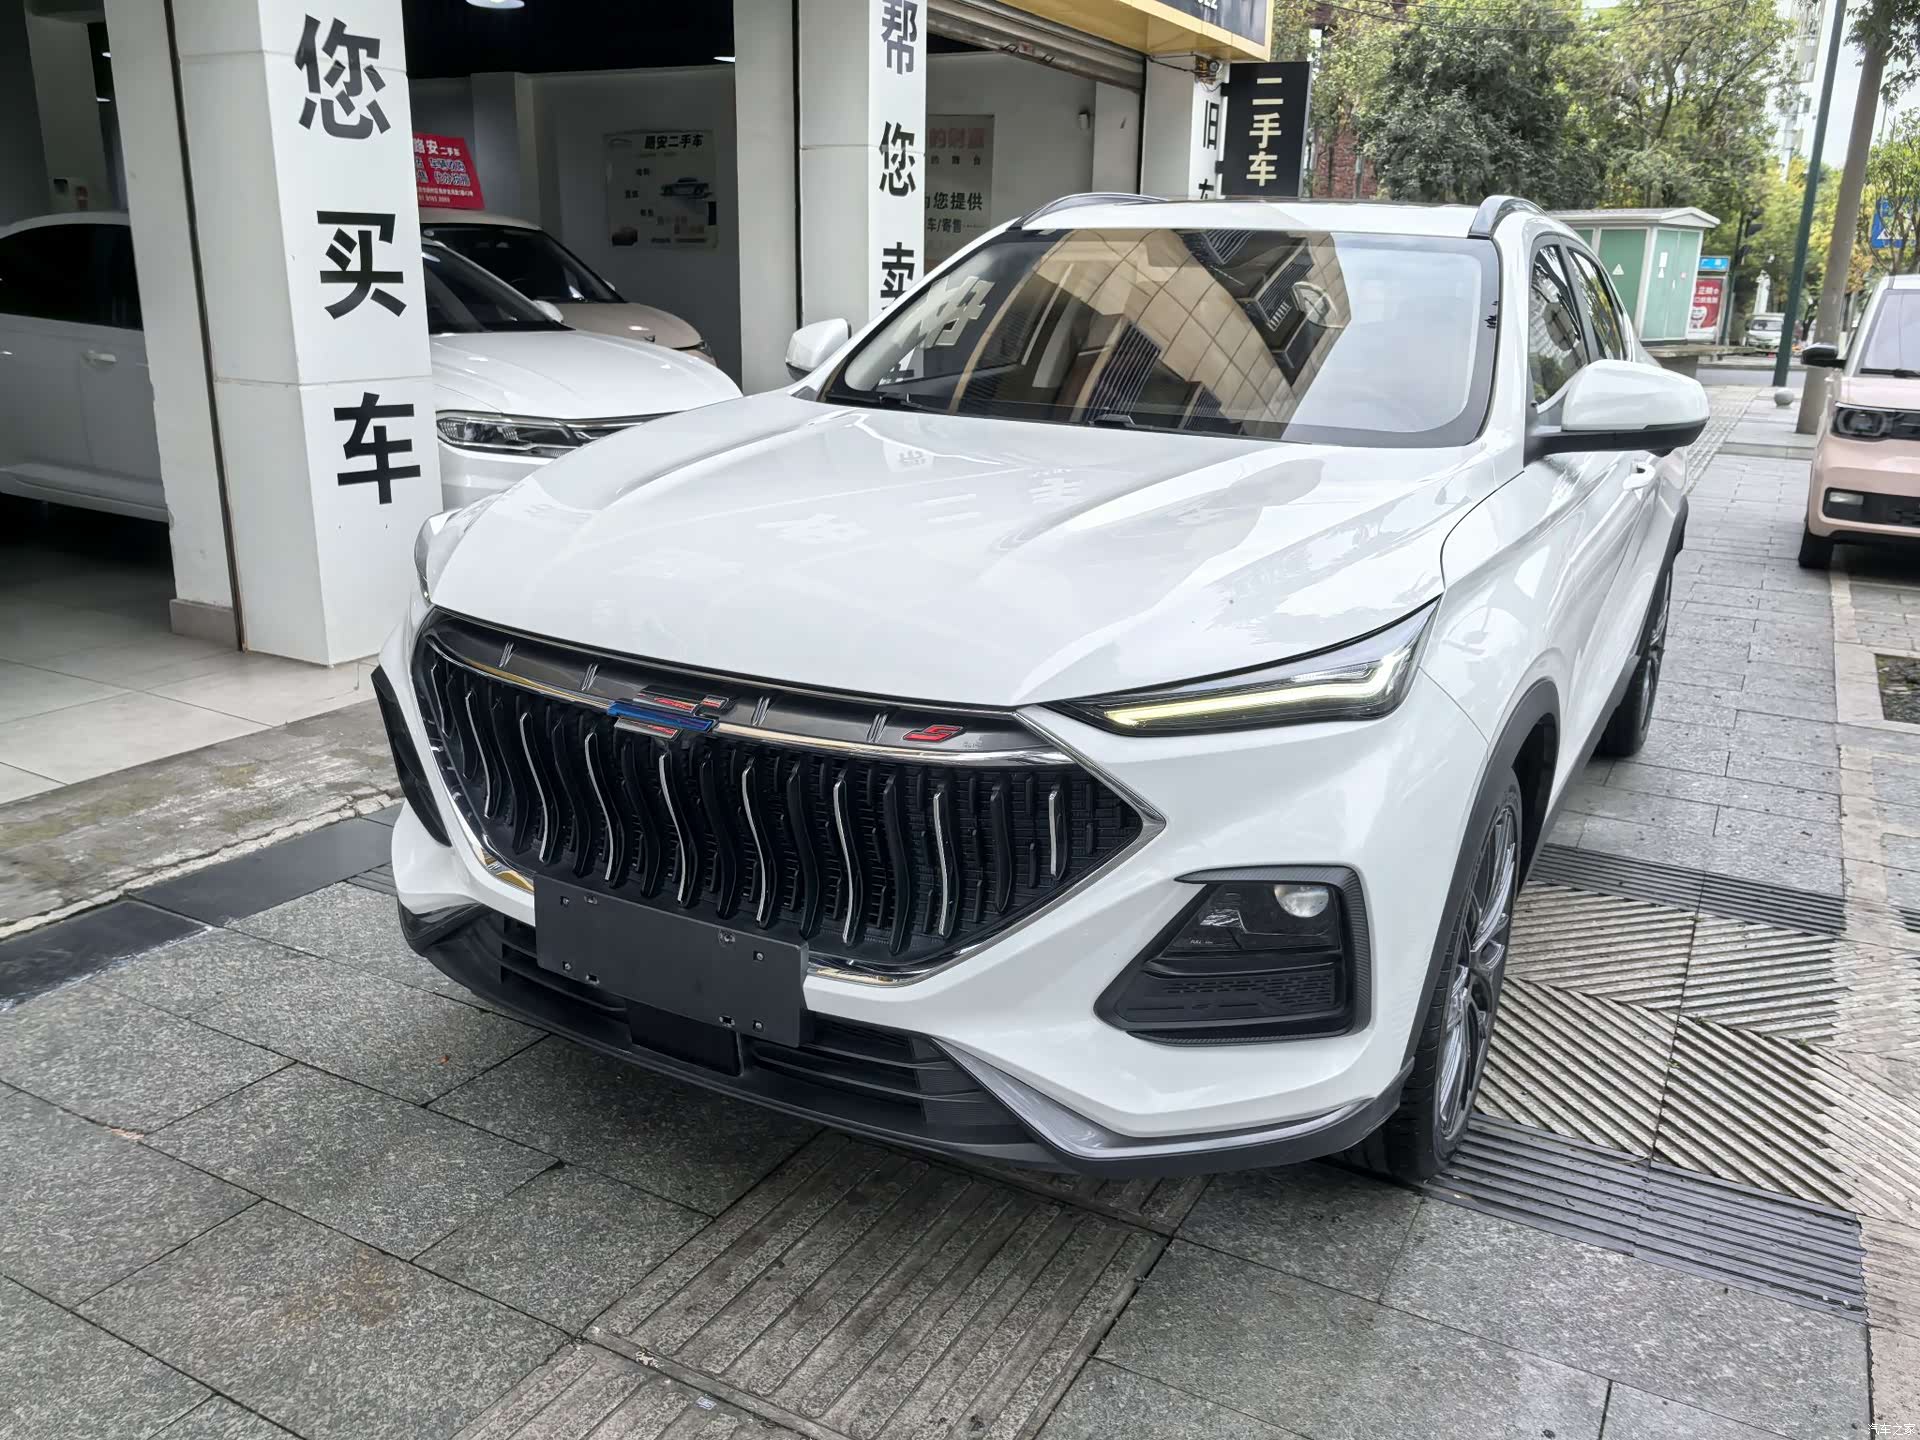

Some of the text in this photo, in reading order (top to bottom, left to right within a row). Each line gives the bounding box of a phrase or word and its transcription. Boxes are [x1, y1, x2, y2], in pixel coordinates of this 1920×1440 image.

[295, 14, 422, 505] 您买车
[1246, 77, 1285, 188] 二手车
